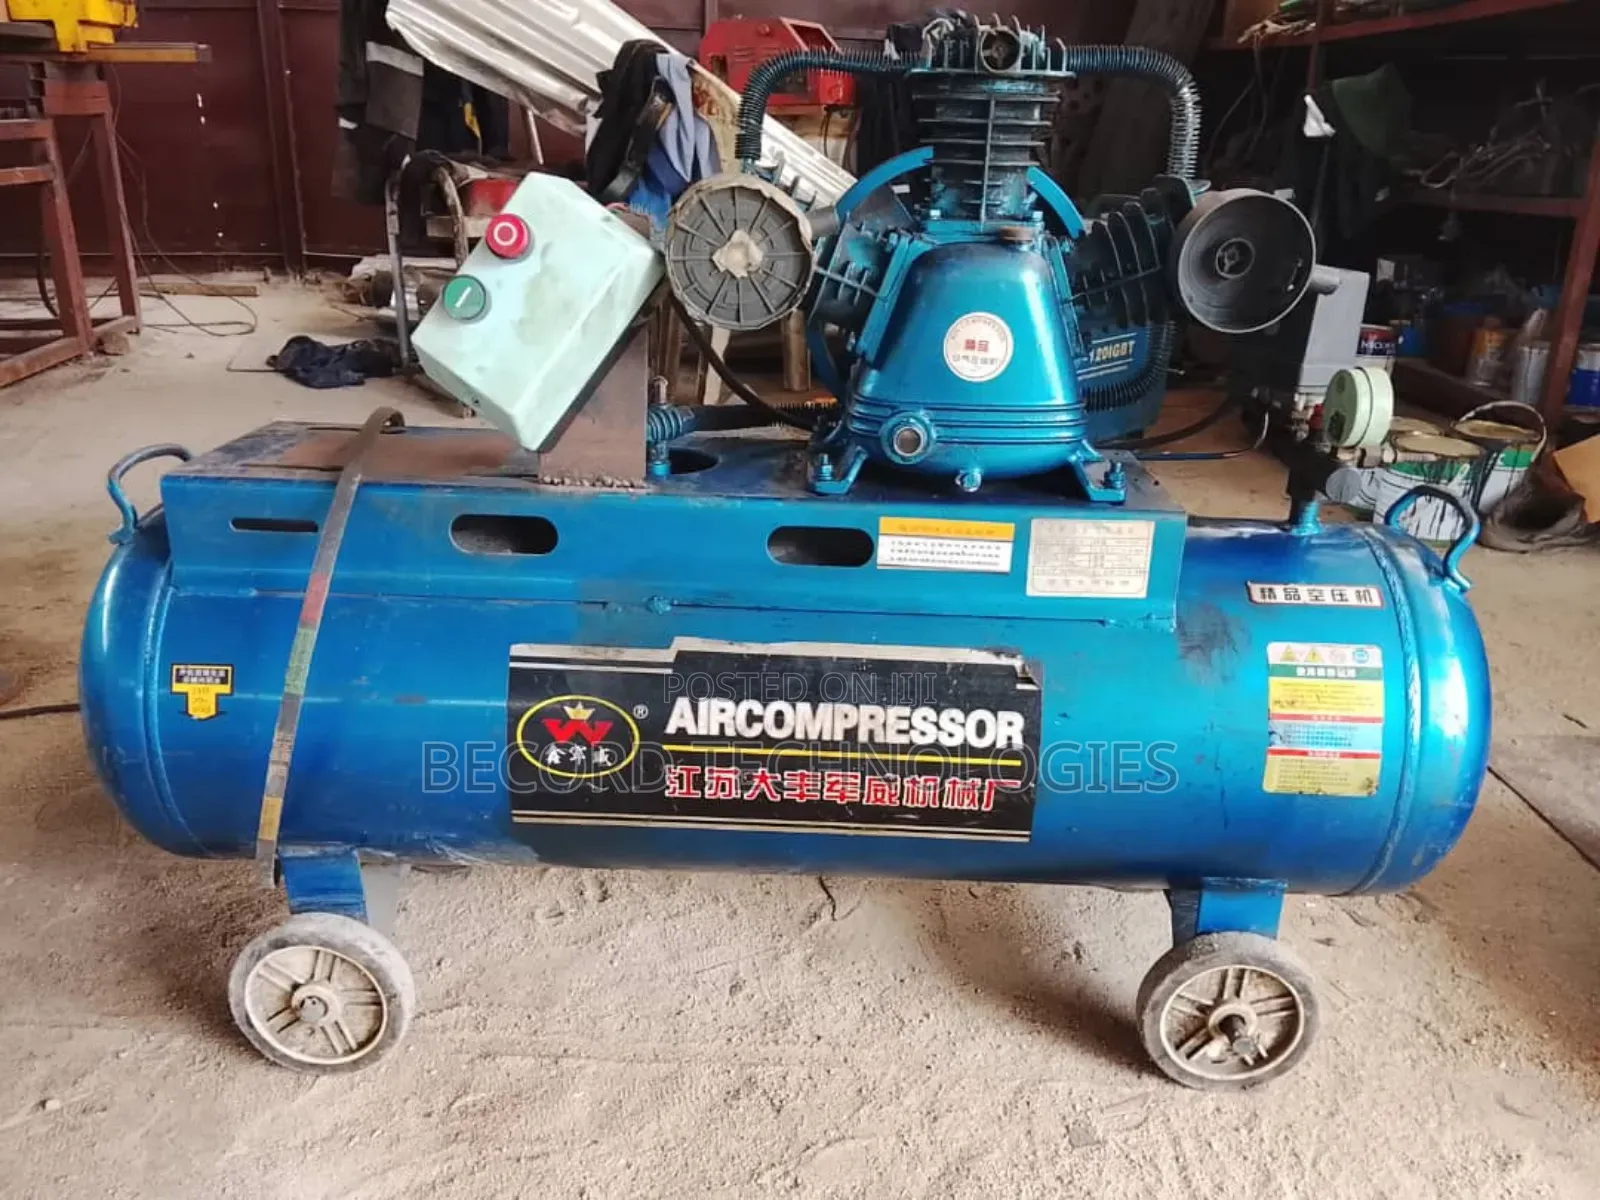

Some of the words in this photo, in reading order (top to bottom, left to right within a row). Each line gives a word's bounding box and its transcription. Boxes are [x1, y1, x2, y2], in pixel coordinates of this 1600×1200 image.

[1260, 587, 1374, 604] 精品空压机
[664, 696, 1025, 750] AIRCOMPRESSOR
[665, 763, 1022, 811] 江苏大丰军威机械厂
